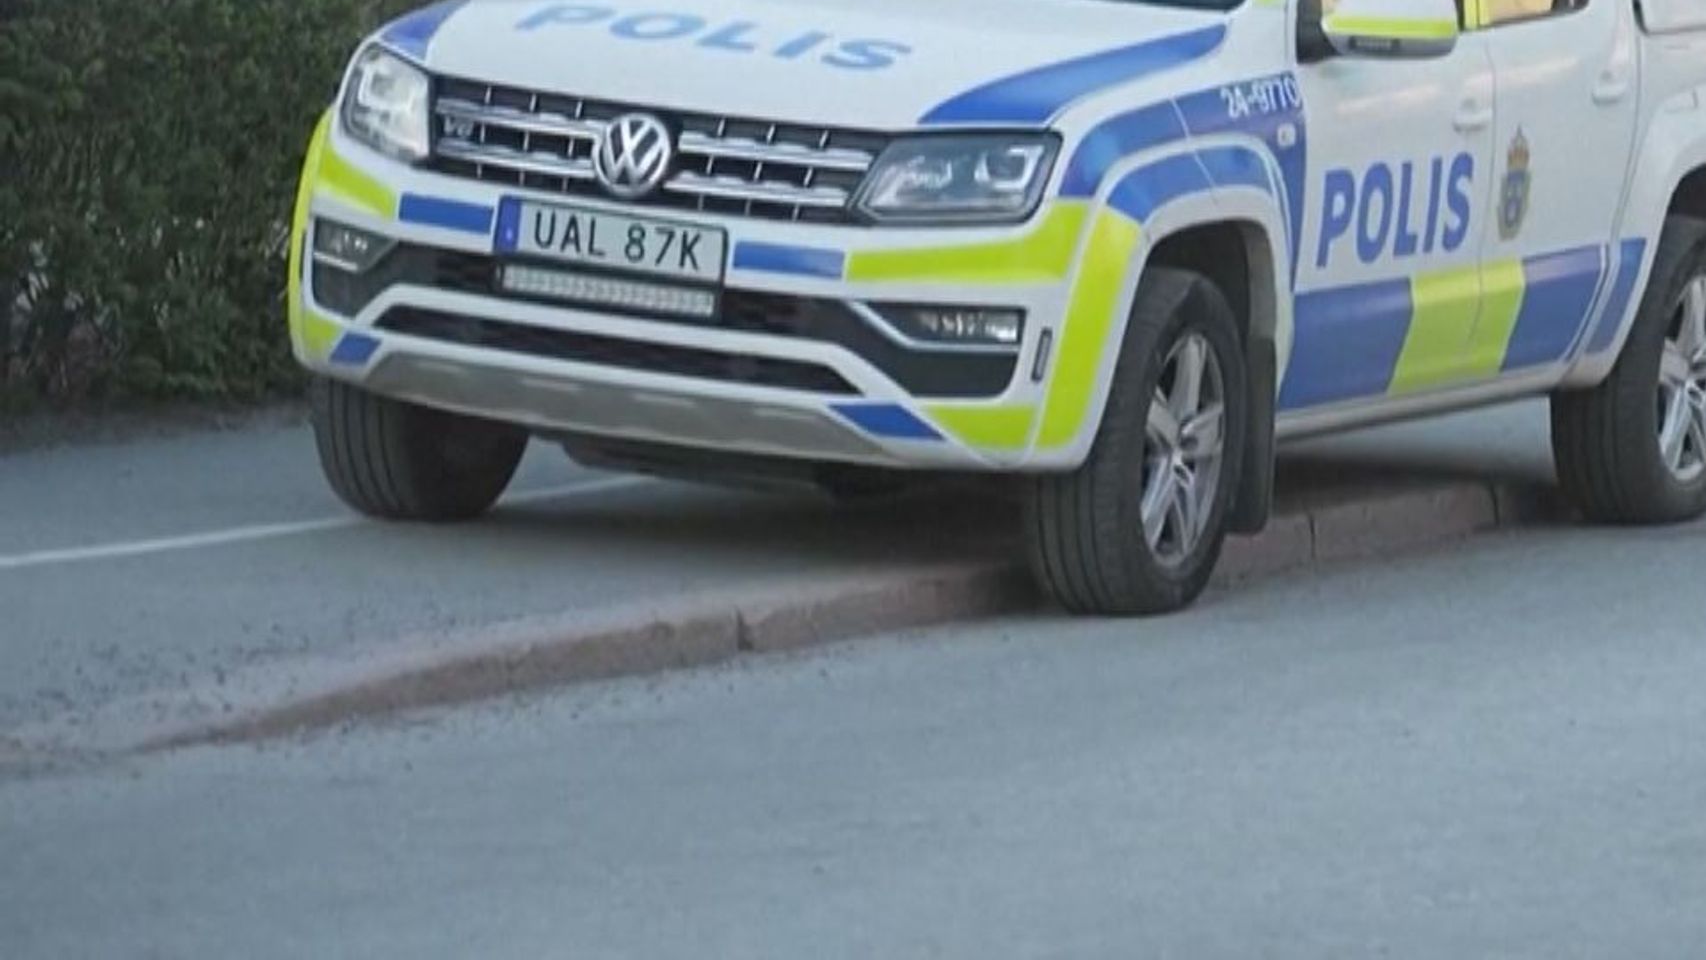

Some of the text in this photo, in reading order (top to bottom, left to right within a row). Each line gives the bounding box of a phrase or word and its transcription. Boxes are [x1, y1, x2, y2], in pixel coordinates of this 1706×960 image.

[514, 3, 913, 70] POLIS
[1220, 77, 1299, 118] 24-9770
[533, 209, 702, 270] UAL 87K
[1316, 150, 1475, 269] POLIS
